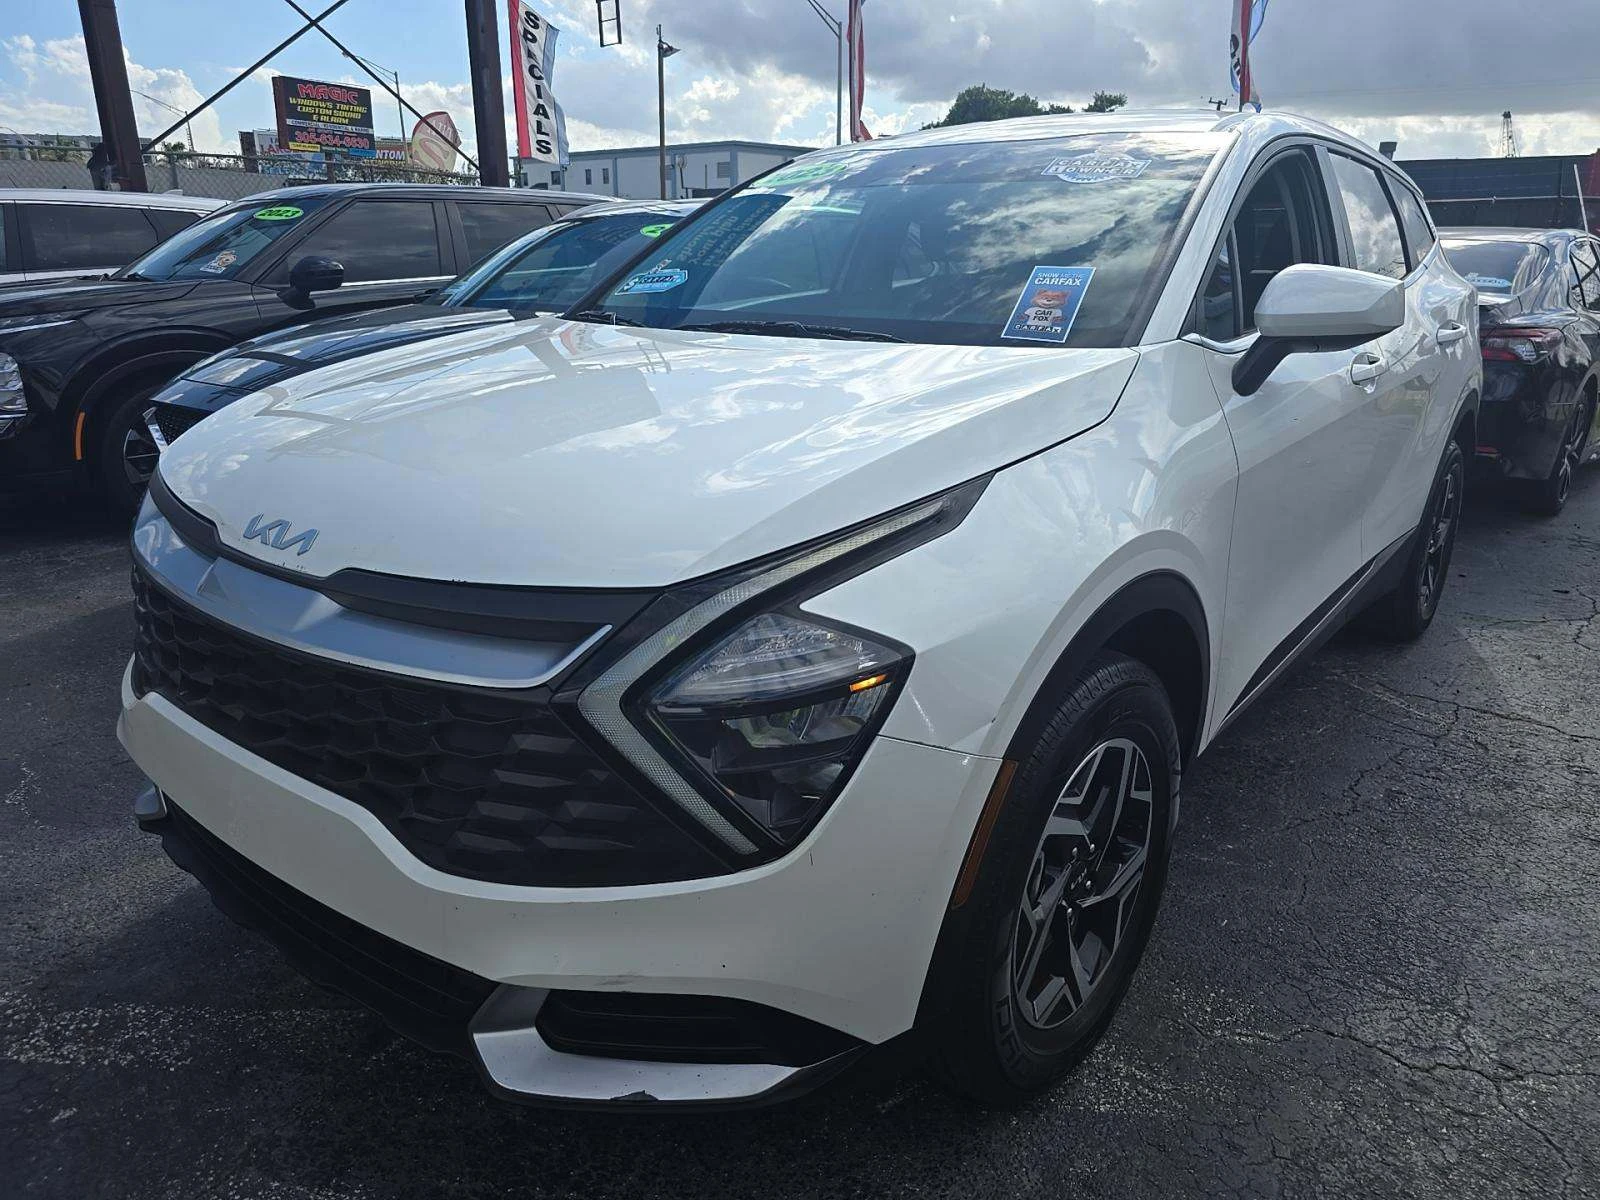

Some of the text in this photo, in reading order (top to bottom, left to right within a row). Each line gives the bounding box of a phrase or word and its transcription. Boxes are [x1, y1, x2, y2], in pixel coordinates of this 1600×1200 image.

[523, 11, 552, 154] SPECIALS
[298, 84, 358, 104] MAGIC
[290, 97, 368, 113] WINDOWS TINTING
[297, 106, 360, 119] CUSTOM SOUND
[321, 115, 349, 124] ALARM
[1057, 160, 1147, 168] CARFAX
[1034, 278, 1082, 286] CARFAX
